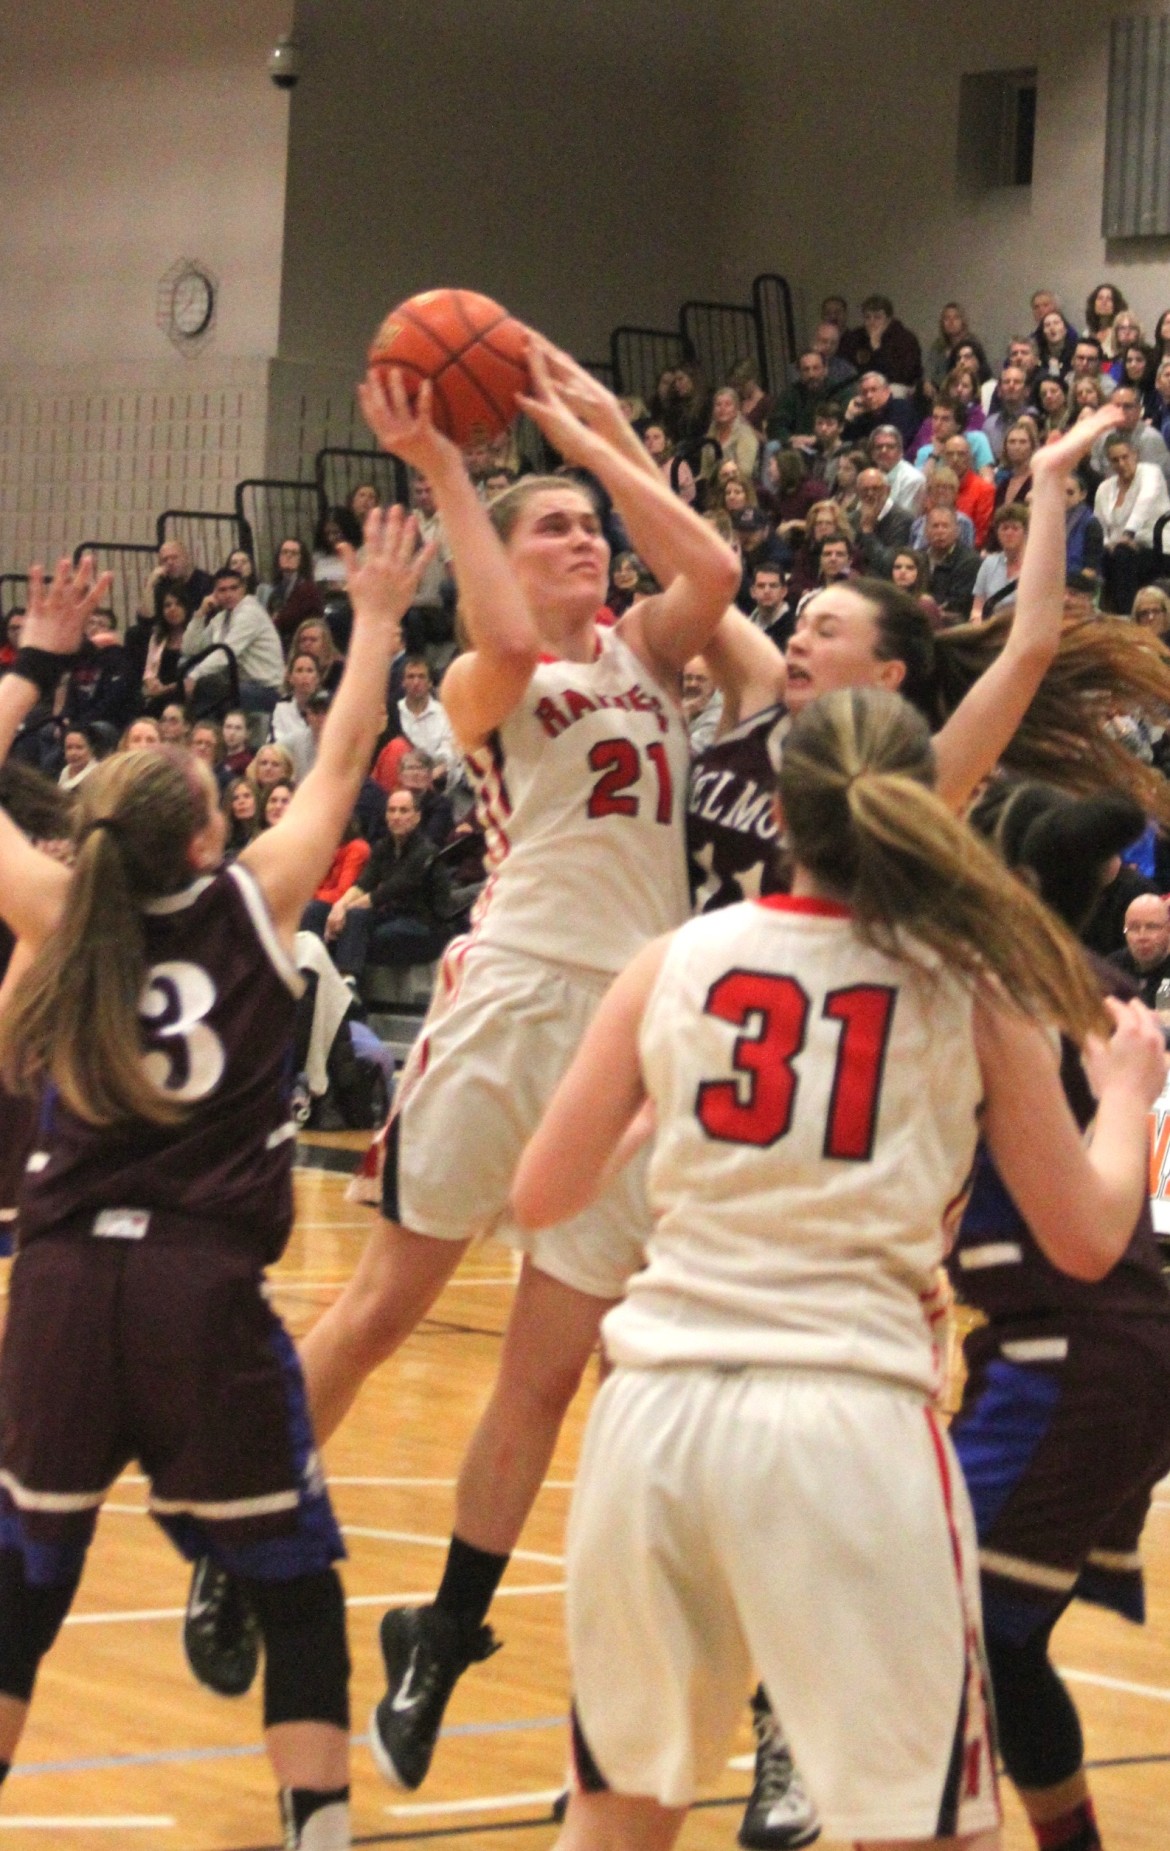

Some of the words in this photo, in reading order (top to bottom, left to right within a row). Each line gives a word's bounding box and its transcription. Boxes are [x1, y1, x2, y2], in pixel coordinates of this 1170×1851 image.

[587, 738, 673, 825] 21
[138, 961, 226, 1102] 3
[695, 968, 898, 1163] 31
